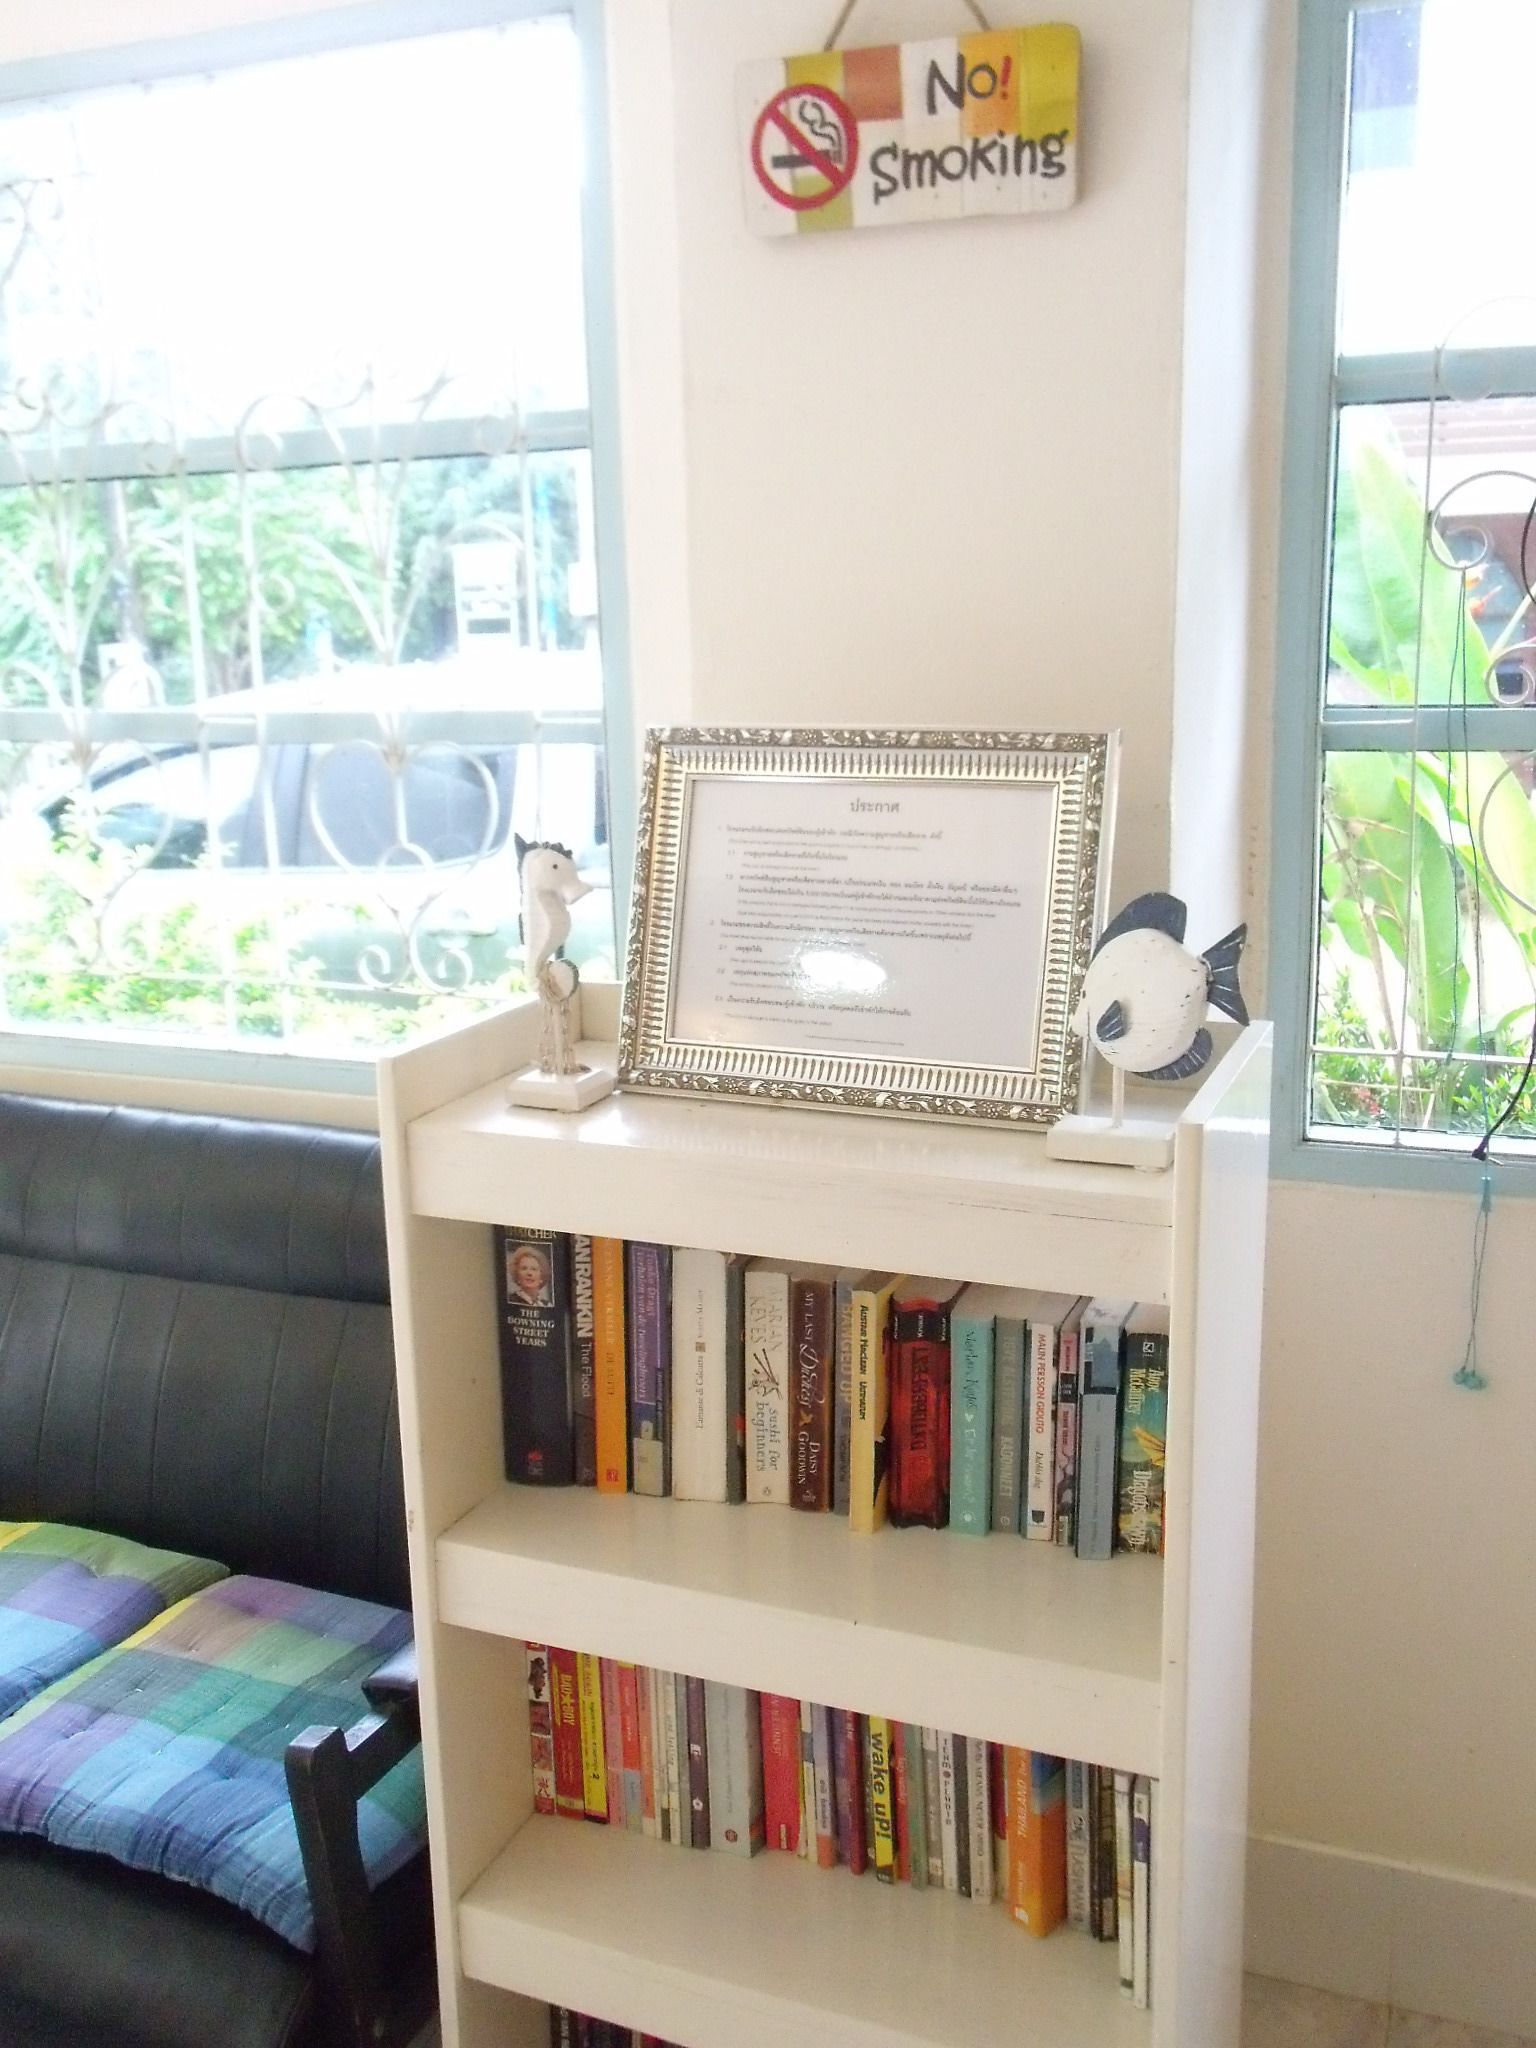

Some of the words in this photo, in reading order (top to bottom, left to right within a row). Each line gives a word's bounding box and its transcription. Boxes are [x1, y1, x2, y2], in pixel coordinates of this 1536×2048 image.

[850, 798, 900, 814] ประกาศ
[576, 1263, 593, 1338] RANKIN
[804, 1292, 814, 1308] MY
[507, 1316, 555, 1328] DOWNING
[513, 1327, 550, 1337] STREET
[638, 1315, 647, 1327] de
[749, 1296, 767, 1344] KEYES
[804, 1313, 815, 1342] LAST
[516, 1337, 547, 1346] YEARS
[581, 1343, 592, 1364] The
[1037, 1334, 1046, 1361] MALIN
[581, 1366, 592, 1397] Flood
[797, 1343, 825, 1409] Duchess
[1036, 1362, 1046, 1399] PERSSON
[1125, 1368, 1146, 1415] McCaffrey
[1144, 1368, 1164, 1392] Anne
[752, 1401, 769, 1472] beginners
[769, 1407, 781, 1443] sushi
[769, 1450, 782, 1471] for
[797, 1431, 810, 1485] GOODWIN
[809, 1441, 821, 1475] DAISY
[871, 1733, 888, 1794] wake
[875, 1802, 891, 1839] up!
[1016, 1779, 1028, 1838] THAILAND
